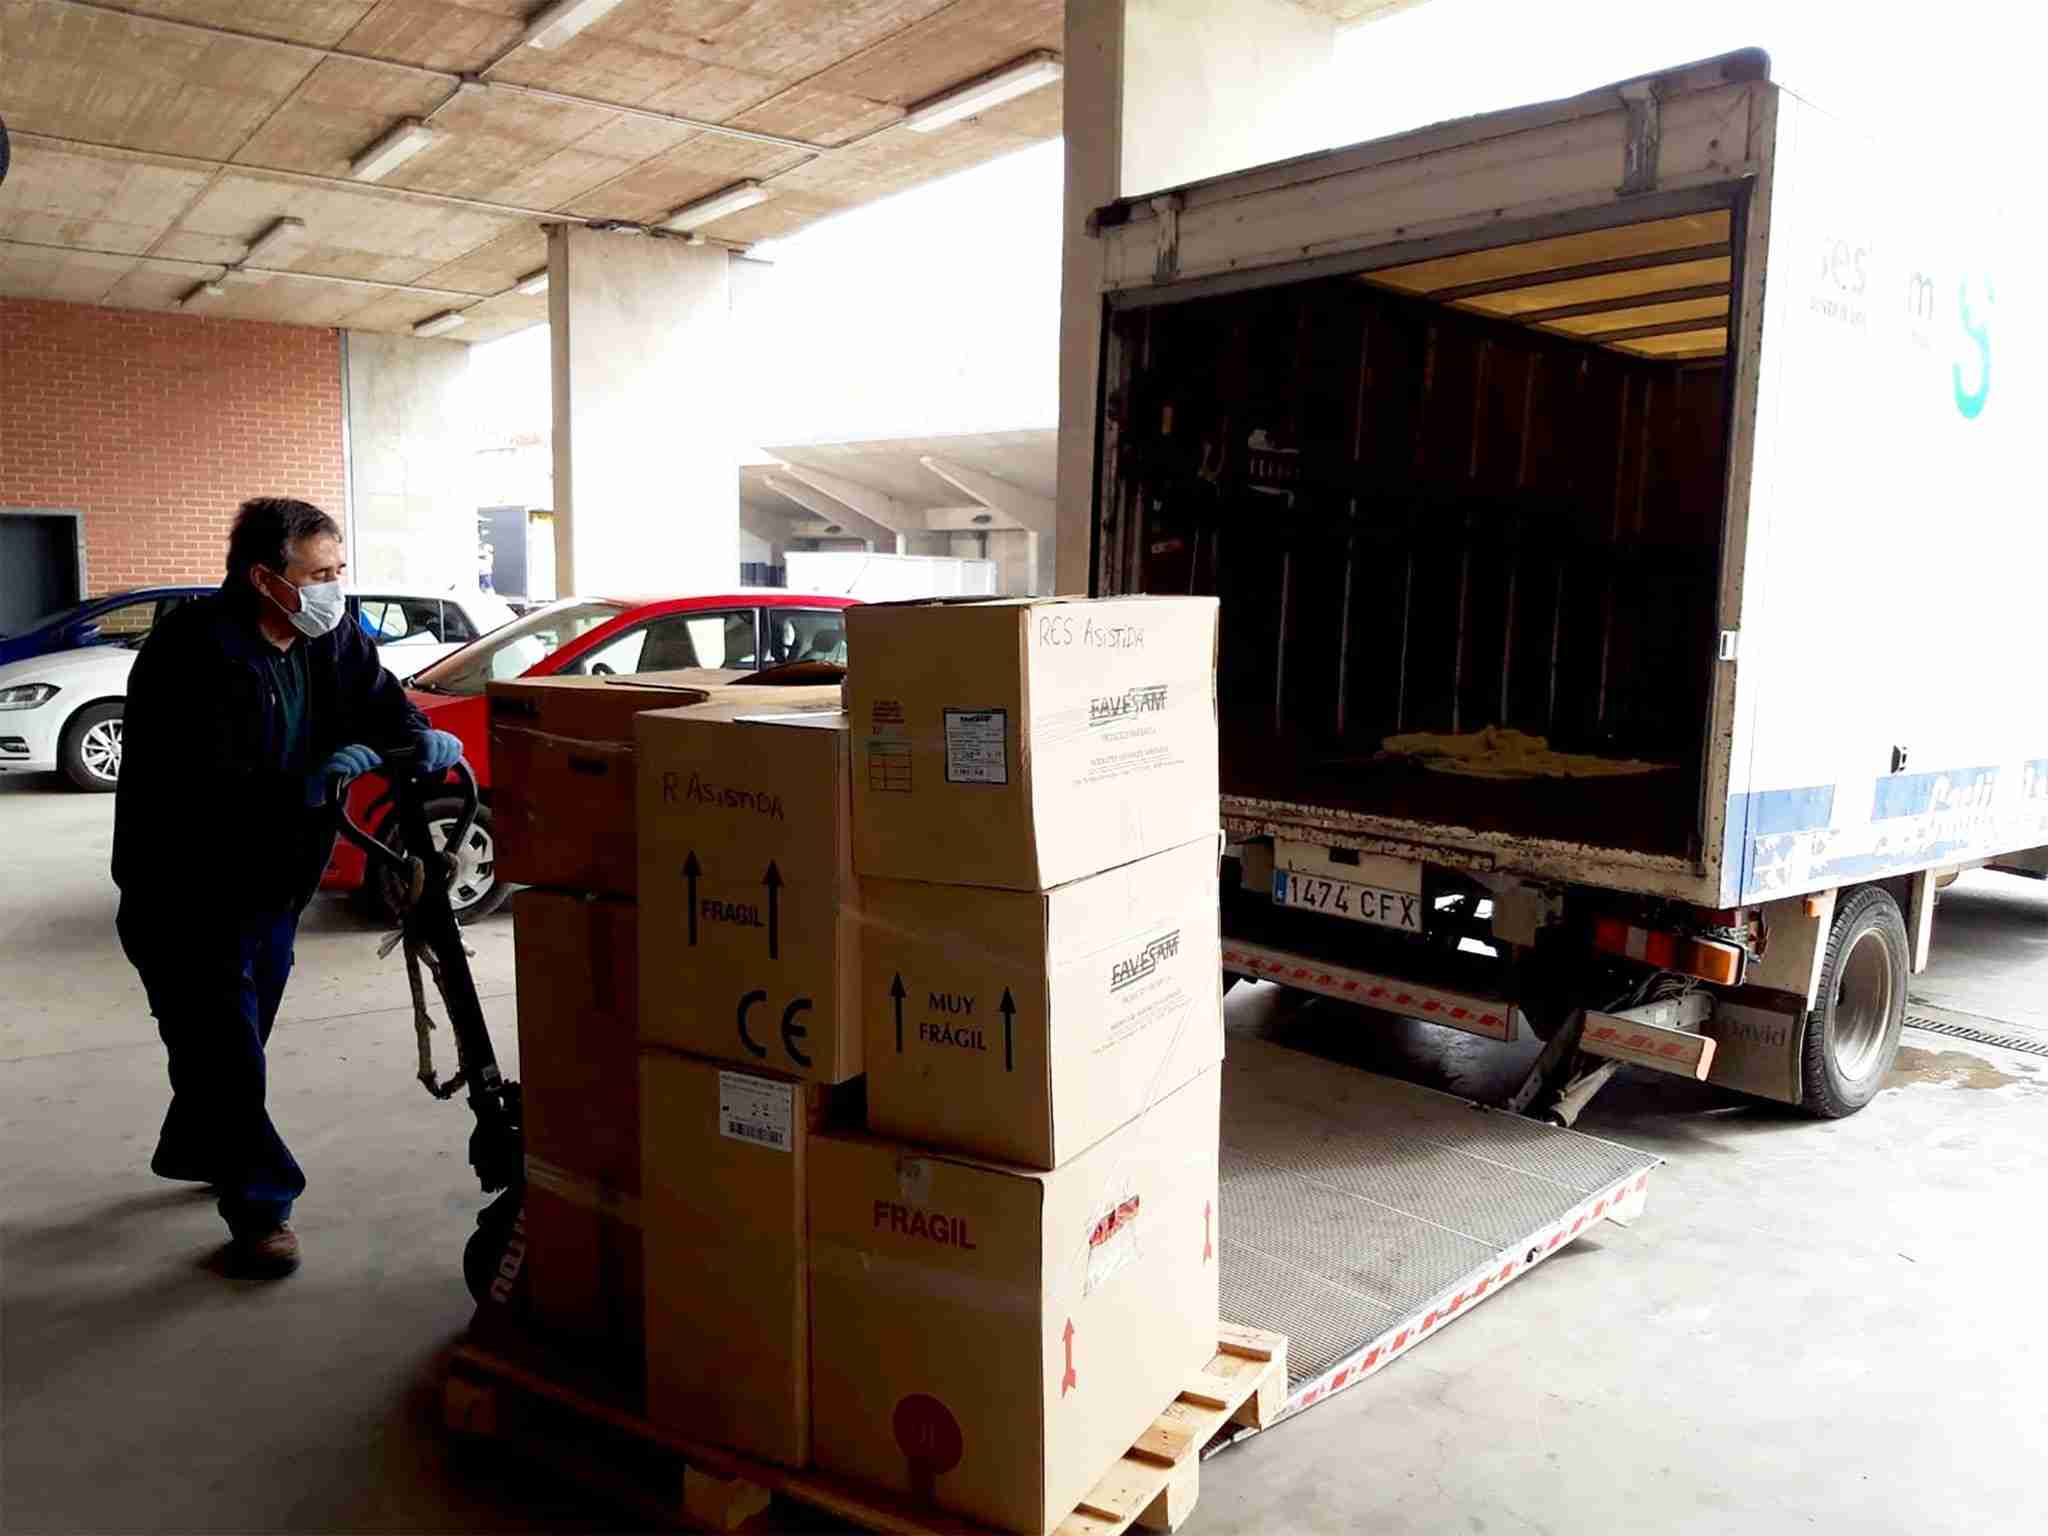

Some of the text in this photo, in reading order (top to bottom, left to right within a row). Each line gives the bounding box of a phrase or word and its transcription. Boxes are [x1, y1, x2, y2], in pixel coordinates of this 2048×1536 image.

[1089, 685, 1169, 724] FAVESAM
[1289, 876, 1416, 927] 1474 CFX
[1111, 931, 1181, 990] FAVESAM
[737, 988, 815, 1069] CE
[928, 991, 976, 1015] MUY
[919, 1021, 986, 1052] FRÁGIL
[873, 1199, 977, 1250] FRAGIL
